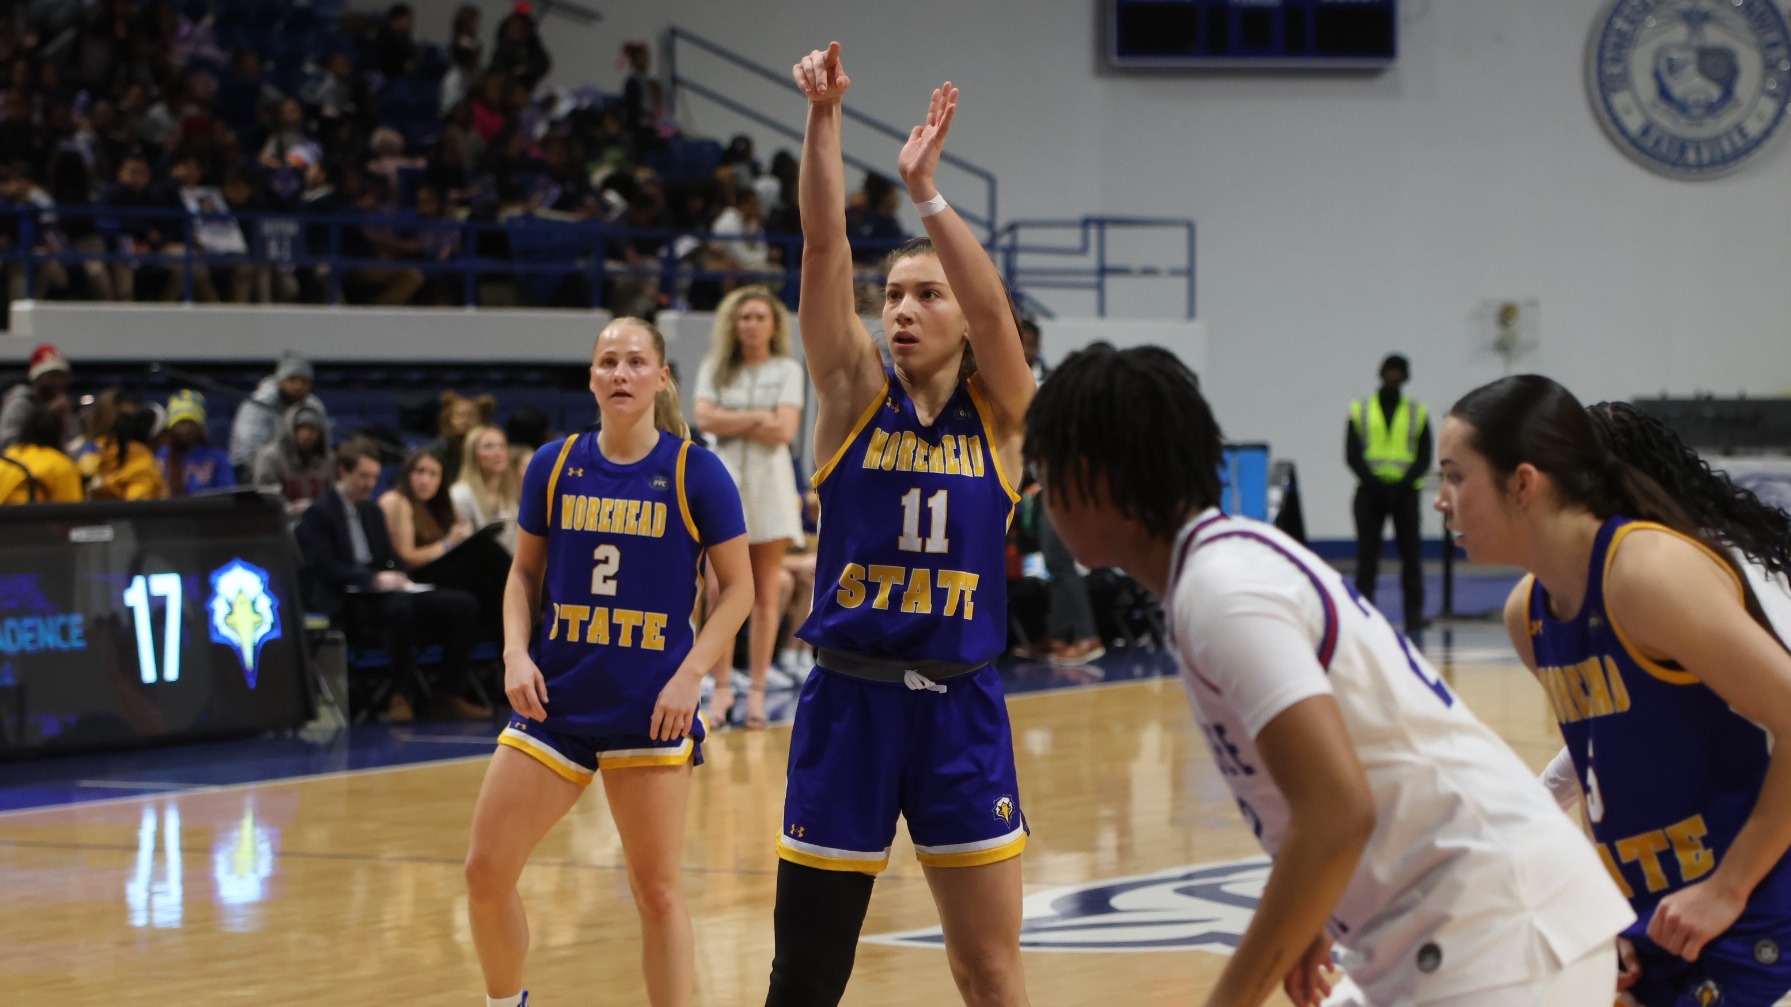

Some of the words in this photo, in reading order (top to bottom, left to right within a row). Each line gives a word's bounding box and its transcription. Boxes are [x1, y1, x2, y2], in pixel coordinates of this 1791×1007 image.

[862, 427, 985, 478] MOREHEAD
[561, 494, 668, 538] MOREHEAD
[898, 487, 950, 554] 11
[590, 543, 621, 597] 2
[836, 562, 980, 621] STATE
[0, 613, 87, 654] DENCE
[123, 572, 182, 684] 17
